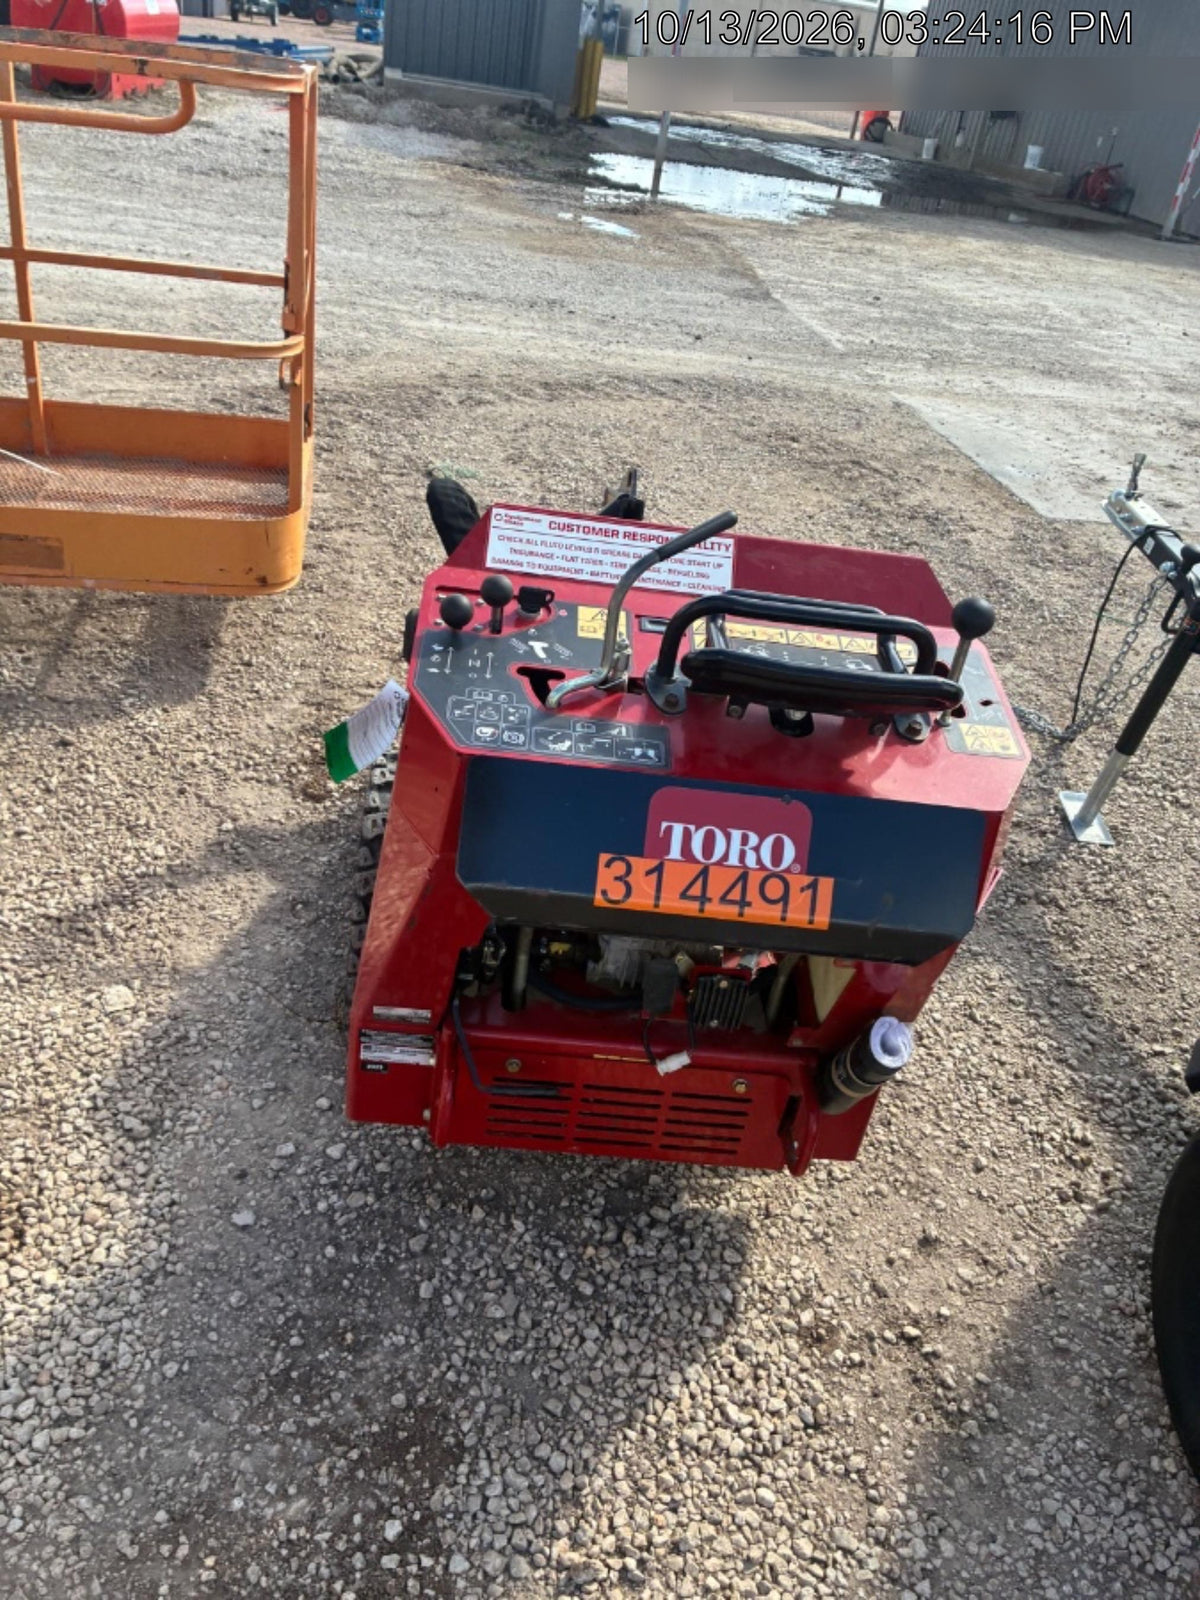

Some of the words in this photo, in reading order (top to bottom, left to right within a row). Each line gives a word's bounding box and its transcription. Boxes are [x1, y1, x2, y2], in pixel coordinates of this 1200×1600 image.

[548, 520, 620, 539] CUSTOMER
[509, 547, 554, 559] INSURANCE
[687, 559, 711, 568] START
[601, 855, 820, 925] 314491
